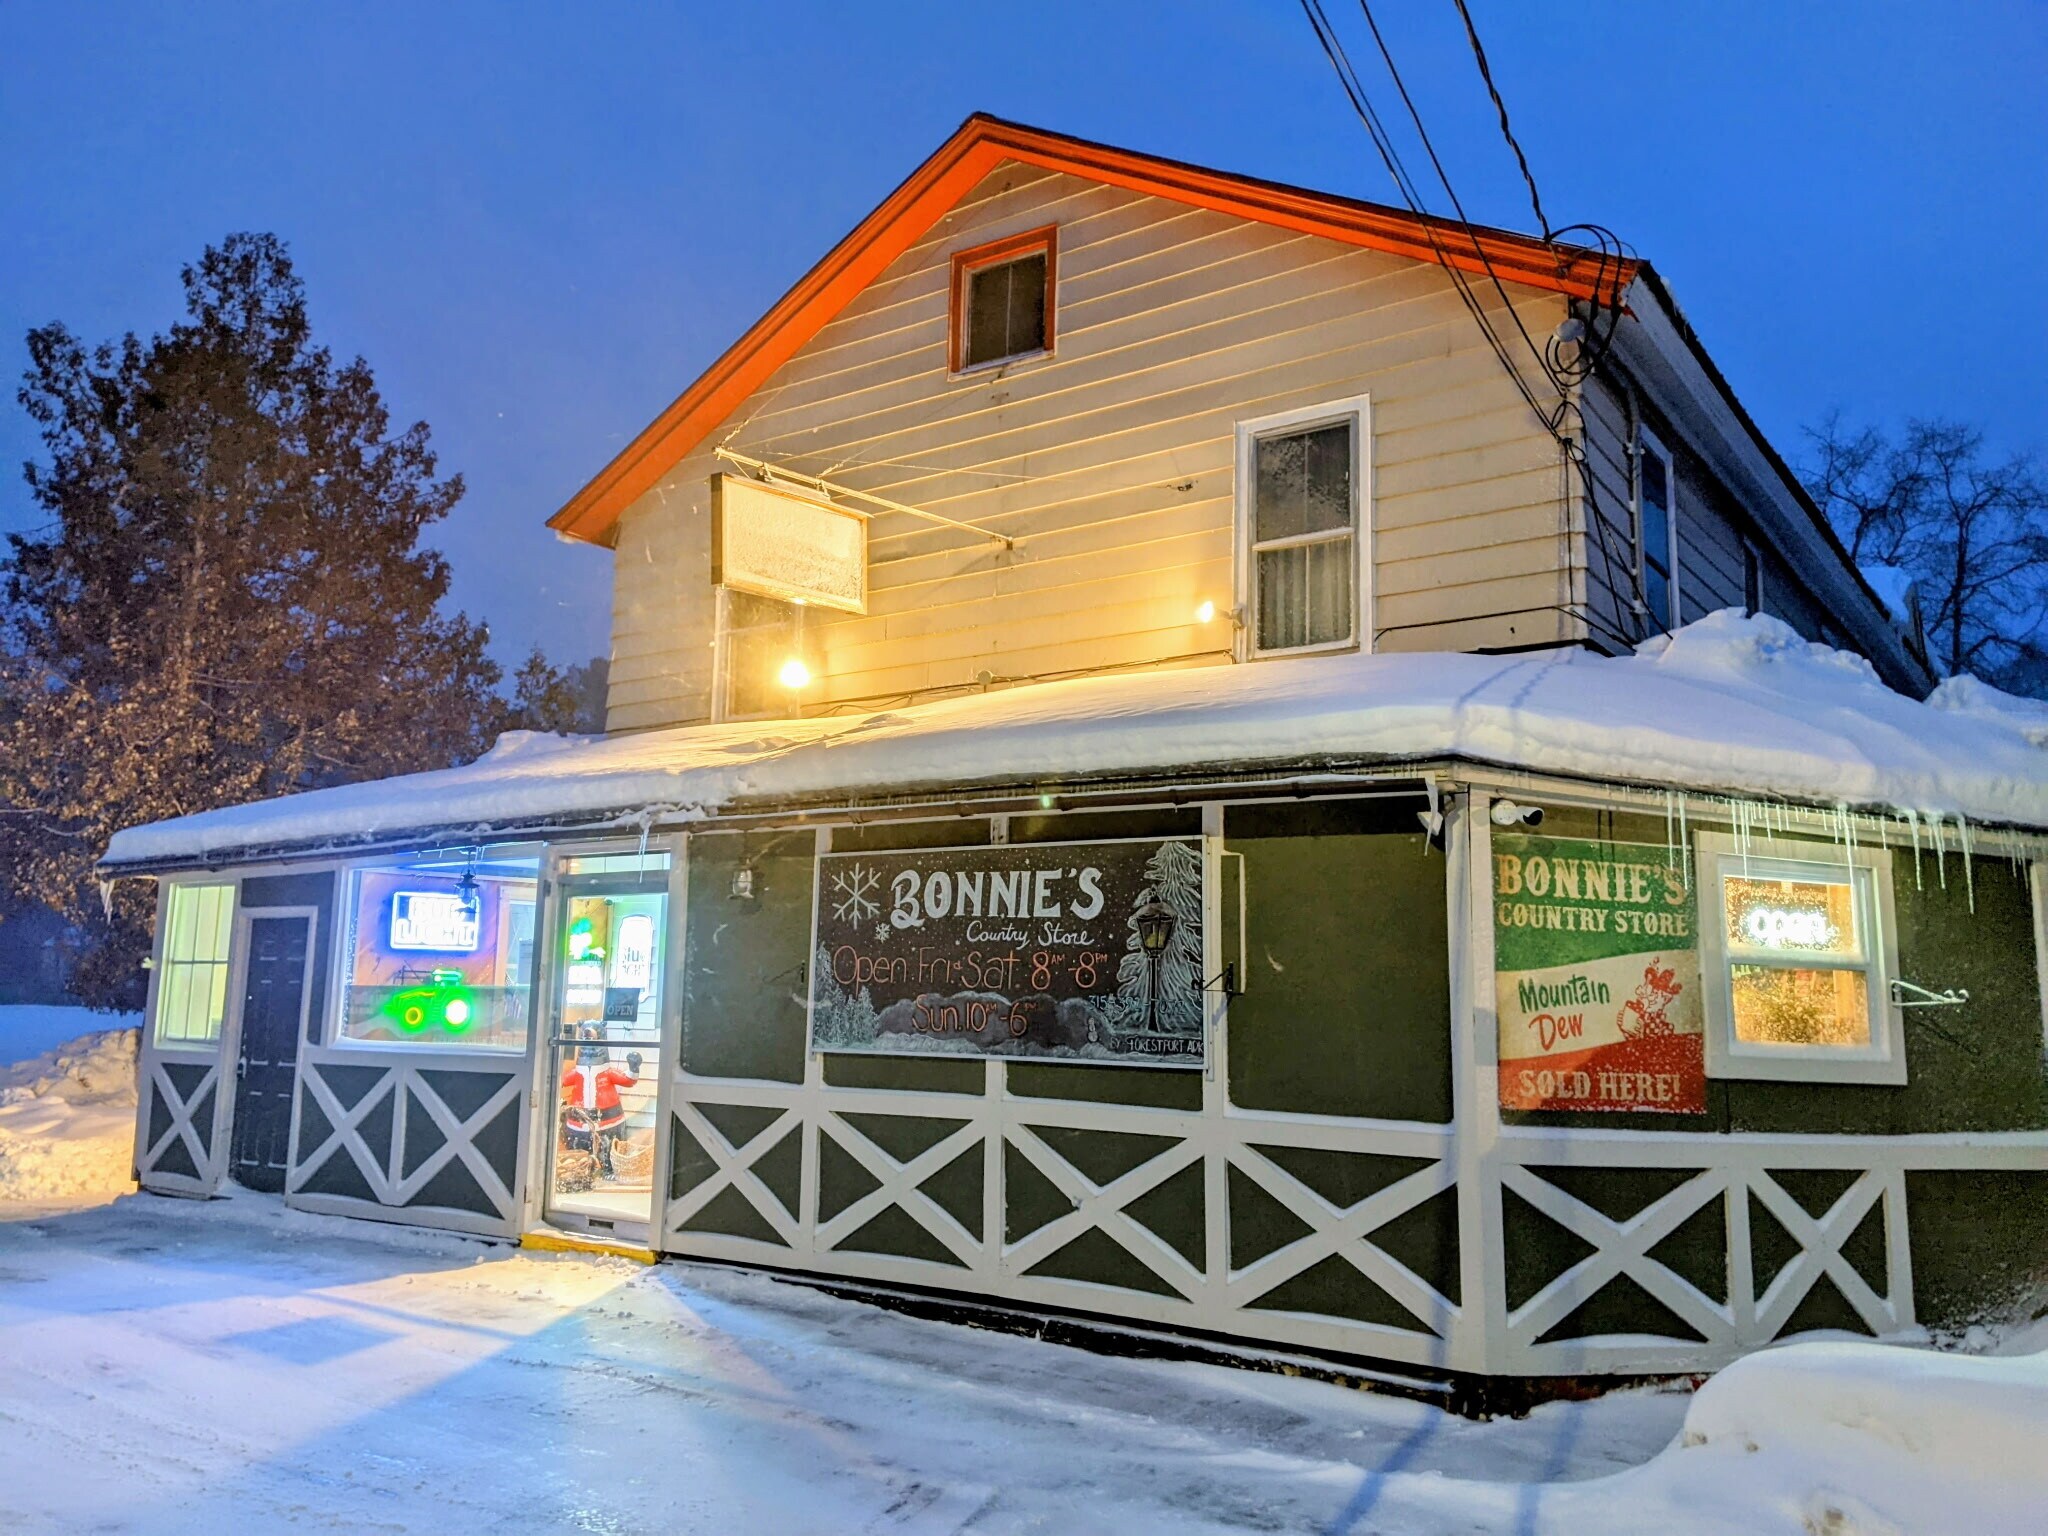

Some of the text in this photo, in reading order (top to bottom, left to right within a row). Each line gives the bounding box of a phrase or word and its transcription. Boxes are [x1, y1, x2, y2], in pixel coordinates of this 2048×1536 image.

[890, 867, 1104, 929] BONNIE'S
[1496, 854, 1688, 905] BONNIE'S
[966, 921, 1094, 950] Country Store
[1498, 903, 1689, 937] COUNTRY STORE
[833, 945, 906, 999] Open
[607, 1003, 634, 1016] OPEN
[1518, 974, 1610, 1013] Mountain
[1529, 1013, 1584, 1050] Dew
[1519, 1069, 1681, 1102] SOLD HERE!
